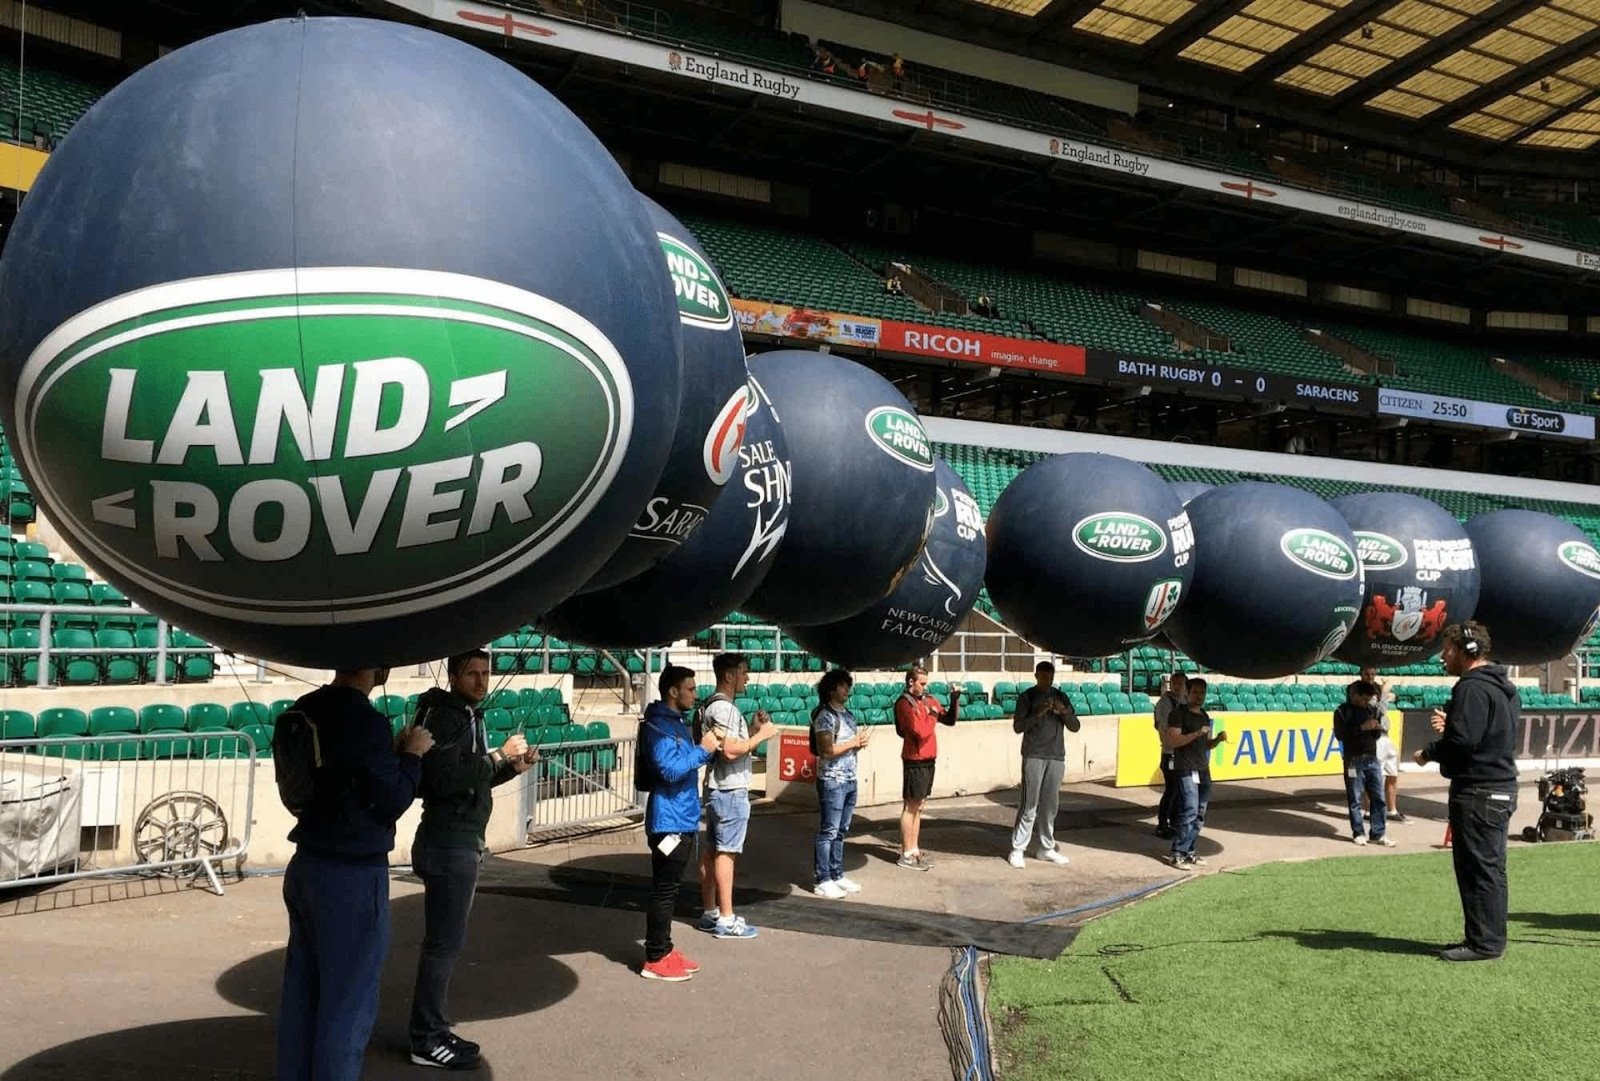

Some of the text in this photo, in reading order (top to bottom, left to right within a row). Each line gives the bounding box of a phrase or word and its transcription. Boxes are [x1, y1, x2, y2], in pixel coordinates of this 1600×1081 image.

[685, 57, 800, 99] England Rugby
[1062, 143, 1150, 174] England Rugby
[1338, 204, 1427, 232] englandrugby.com
[905, 331, 980, 357] RICOH
[1118, 360, 1156, 377] BATH
[1160, 365, 1205, 383] RUGBY
[1211, 372, 1222, 386] 0
[1256, 378, 1266, 392] 0
[1296, 384, 1360, 402] SARACENS
[101, 356, 431, 465] LAND
[1379, 395, 1467, 417] CITIZEN 25:50
[886, 414, 921, 440] LAND
[1513, 411, 1560, 429] BT Sport
[738, 440, 776, 468] SALE
[893, 431, 930, 462] ROVER
[149, 441, 543, 562] ROVER
[957, 524, 977, 542] CUP
[1094, 521, 1140, 537] LAND
[1097, 535, 1153, 552] ROVER
[1301, 536, 1340, 556] LAND
[1174, 551, 1190, 568] CUP
[1303, 548, 1349, 572] ROVER
[1416, 570, 1441, 582] CUP
[783, 757, 796, 777] 3
